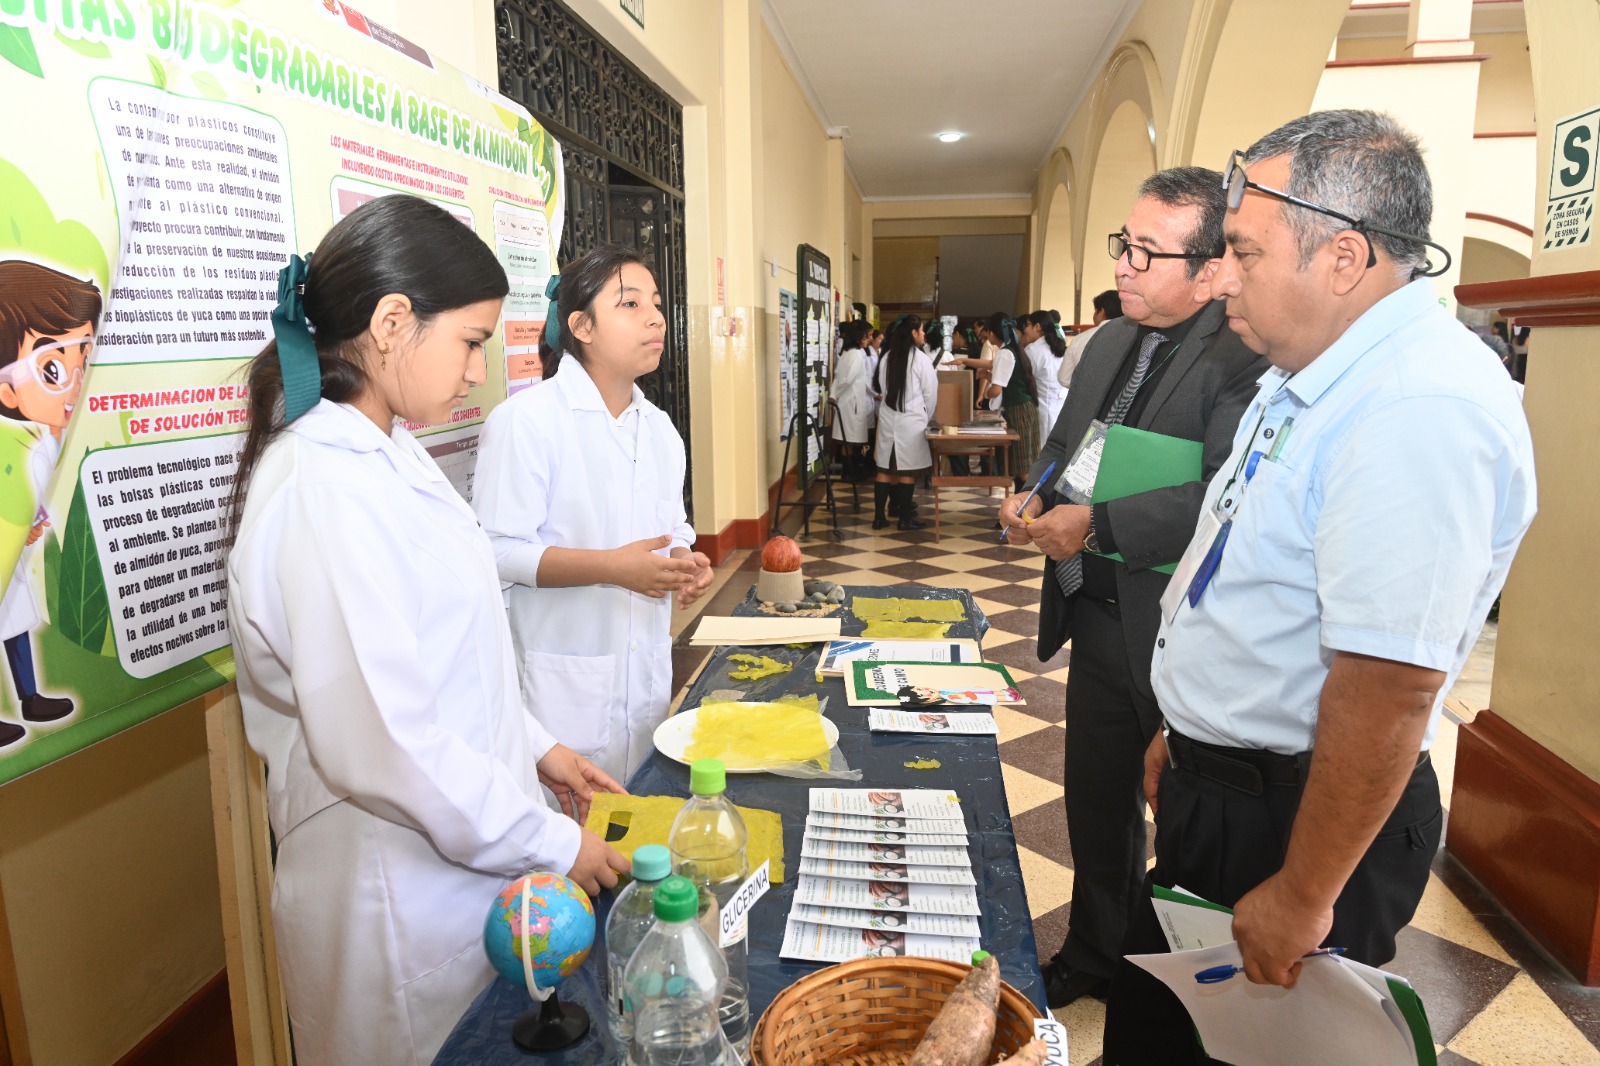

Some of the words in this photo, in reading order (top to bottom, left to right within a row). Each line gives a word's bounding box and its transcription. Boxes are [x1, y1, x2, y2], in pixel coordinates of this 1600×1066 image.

[108, 97, 121, 111] La
[166, 111, 180, 125] por
[188, 114, 239, 133] plásticos
[116, 124, 131, 138] una
[136, 126, 144, 140] de
[175, 136, 244, 155] preocupaciones
[331, 135, 341, 149] LOS
[390, 88, 403, 130] A
[408, 95, 448, 147] BASE
[452, 113, 471, 154] DE
[474, 125, 528, 176] ALMIDÓN
[122, 148, 132, 162] de
[165, 155, 185, 169] Ante
[192, 158, 212, 172] esta
[342, 157, 374, 177] INCLUYENDO
[375, 166, 392, 182] COSTOS
[1560, 124, 1592, 188] S
[165, 178, 192, 192] como
[197, 182, 214, 193] una
[219, 182, 255, 199] alternativa
[160, 199, 171, 212] al
[179, 200, 228, 216] plástico
[234, 206, 284, 224] convencional.
[1552, 211, 1566, 220] ZONA
[1566, 206, 1585, 218] SEGURA
[1564, 218, 1579, 228] CASOS
[164, 222, 202, 235] procura
[1554, 230, 1561, 238] DE
[1562, 226, 1578, 238] SISMOS
[134, 242, 142, 255] la
[146, 243, 208, 258] preservación
[212, 244, 223, 258] de
[226, 248, 254, 260] nuestros
[256, 248, 287, 263] ecosistemas
[122, 264, 176, 279] reducción
[183, 266, 196, 278] de
[202, 266, 219, 279] los
[224, 268, 257, 281] residuos
[177, 288, 224, 300] realizadas
[226, 288, 258, 302] respaldan
[258, 289, 265, 301] la
[115, 310, 174, 324] bioplásticos
[177, 309, 189, 322] de
[191, 310, 213, 323] yuca
[216, 310, 237, 321] como
[238, 310, 250, 321] una
[156, 332, 177, 347] para
[180, 331, 192, 344] un
[193, 330, 219, 343] futuro
[220, 329, 236, 342] más
[238, 328, 267, 342] sostenible.
[88, 388, 215, 413] DETERMINACION
[218, 386, 234, 401] DE
[236, 384, 248, 399] LA
[130, 418, 150, 435] DE
[154, 408, 224, 433] SOLUCIÓN
[92, 470, 103, 485] El
[107, 465, 154, 484] problema
[157, 456, 211, 476] tecnológico
[214, 453, 234, 467] nace
[97, 492, 114, 508] las
[120, 487, 154, 505] bolsas
[160, 479, 204, 498] plásticas
[102, 512, 143, 532] proceso
[146, 508, 158, 522] de
[161, 497, 215, 520] degradación
[108, 538, 120, 553] al
[122, 530, 170, 550] ambiente.
[172, 525, 184, 539] Se
[186, 519, 217, 537] plantea
[114, 562, 127, 576] de
[130, 552, 165, 572] almidón
[166, 548, 178, 563] de
[180, 544, 202, 562] yuca,
[118, 582, 140, 600] para
[144, 573, 174, 592] obtener
[178, 568, 188, 581] un
[191, 558, 225, 577] material
[122, 606, 136, 620] de
[140, 590, 186, 615] degradarse
[188, 588, 199, 600] en
[126, 628, 136, 643] la
[142, 614, 175, 638] utilidad
[178, 610, 188, 625] de
[192, 605, 206, 620] una
[130, 643, 164, 664] efectos
[166, 630, 194, 652] nocivos
[194, 622, 216, 640] sobre
[217, 618, 226, 632] la
[722, 868, 768, 934] GLICERINA
[1038, 1024, 1063, 1066] YUCA
